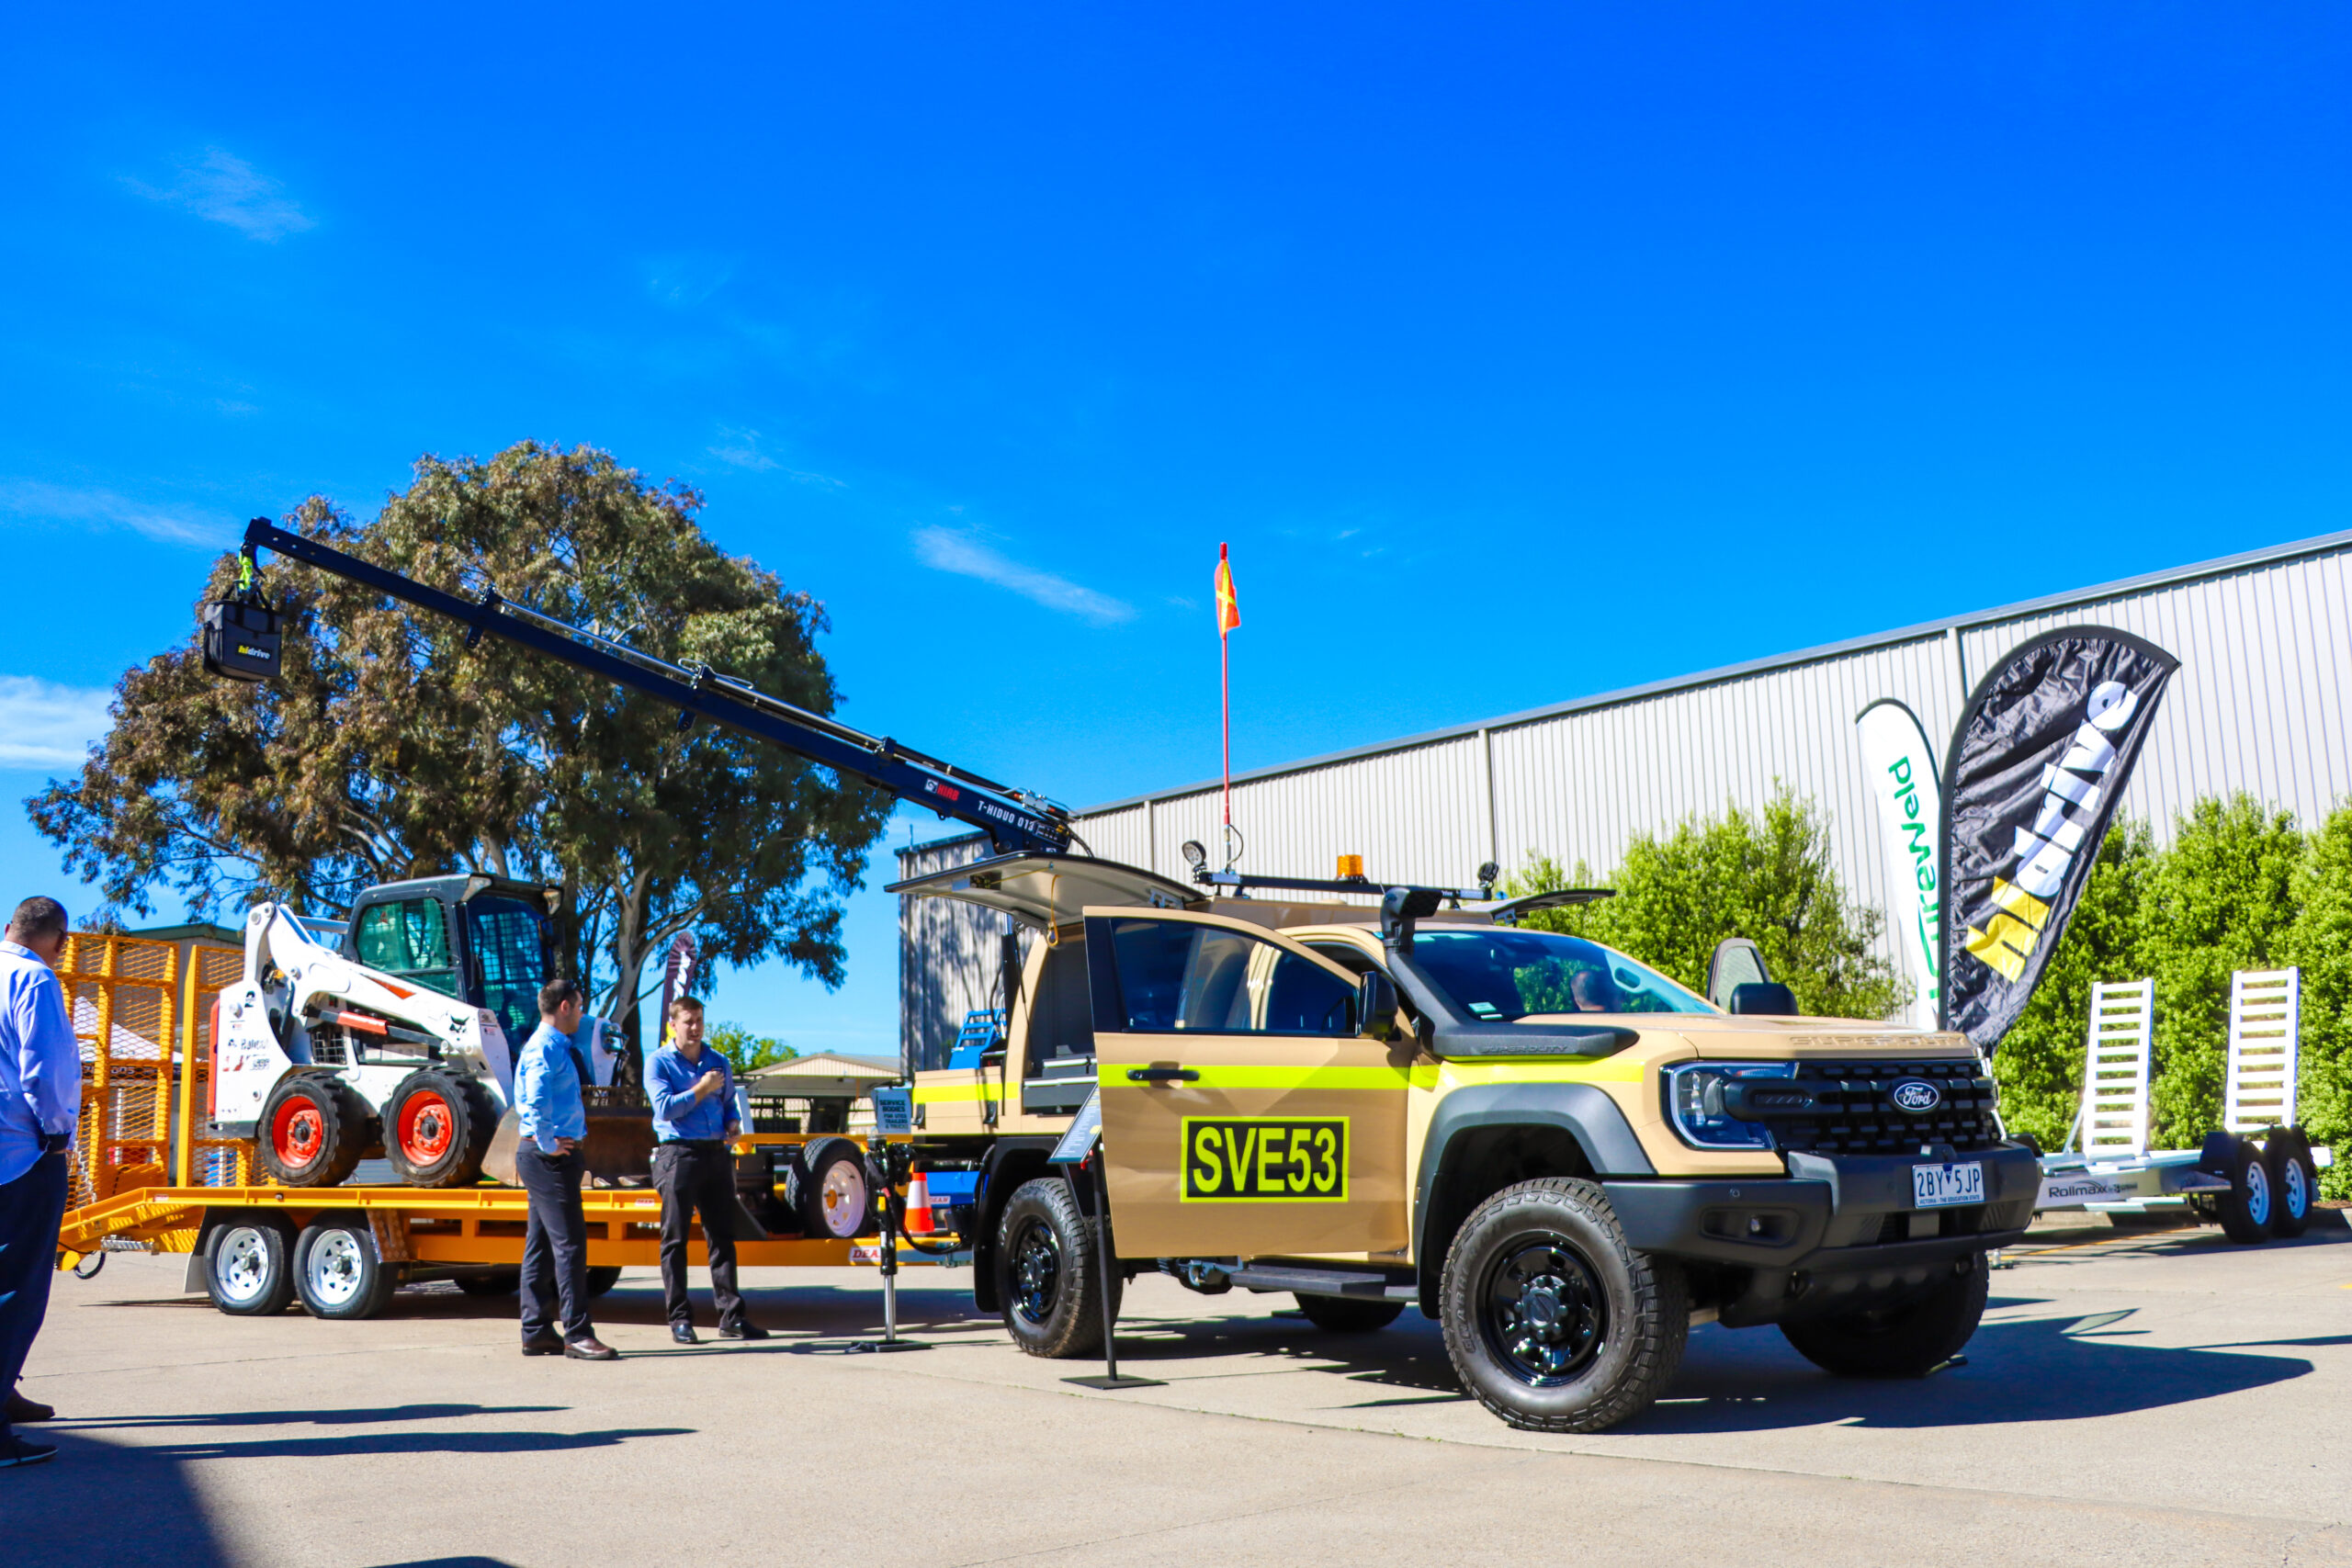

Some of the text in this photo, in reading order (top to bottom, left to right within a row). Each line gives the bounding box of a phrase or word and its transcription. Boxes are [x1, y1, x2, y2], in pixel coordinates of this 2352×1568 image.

[238, 645, 271, 660] hidrive
[937, 784, 960, 801] HIAB
[978, 800, 1015, 824] T-HIDUO
[1966, 681, 2139, 983] hidrive
[1528, 1044, 1568, 1053] DUTY
[1902, 1086, 1932, 1106] Ford
[1193, 1125, 1338, 1194] SVE53
[1917, 1168, 1980, 1197] 2BY 5JP
[852, 1248, 882, 1258] DEA
